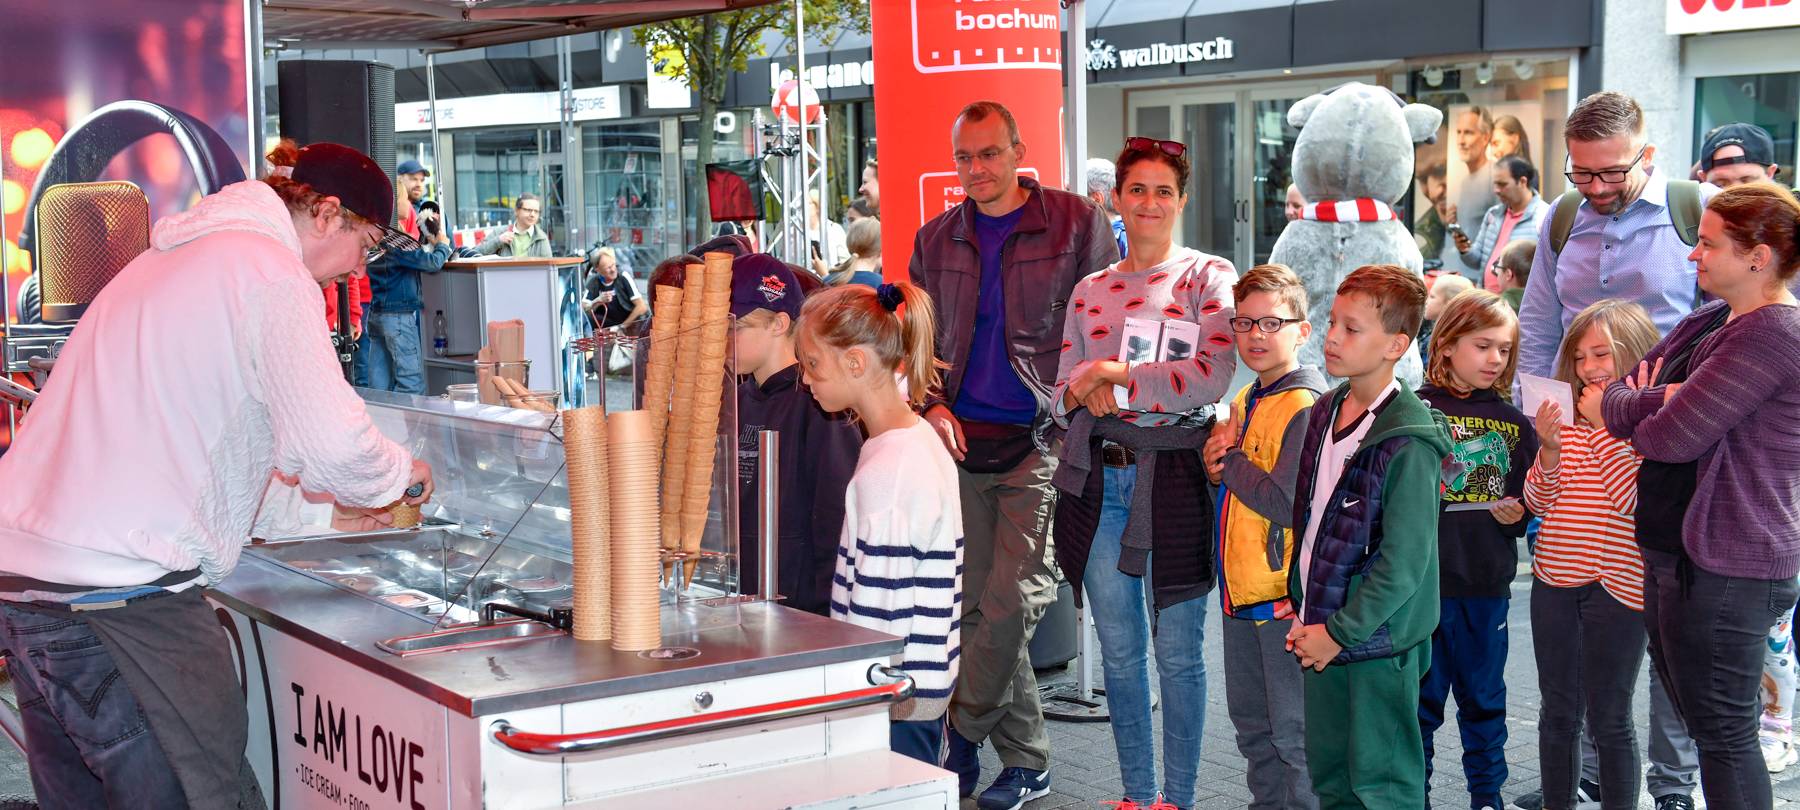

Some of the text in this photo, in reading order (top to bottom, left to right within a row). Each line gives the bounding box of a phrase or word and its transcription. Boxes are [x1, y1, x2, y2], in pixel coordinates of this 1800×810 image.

[955, 8, 1057, 31] bochum
[1119, 37, 1233, 68] walbusch
[1486, 418, 1519, 438] QUIT
[291, 682, 425, 810] I AM LOVE
[301, 763, 314, 789] ICE
[315, 773, 341, 806] CREAM
